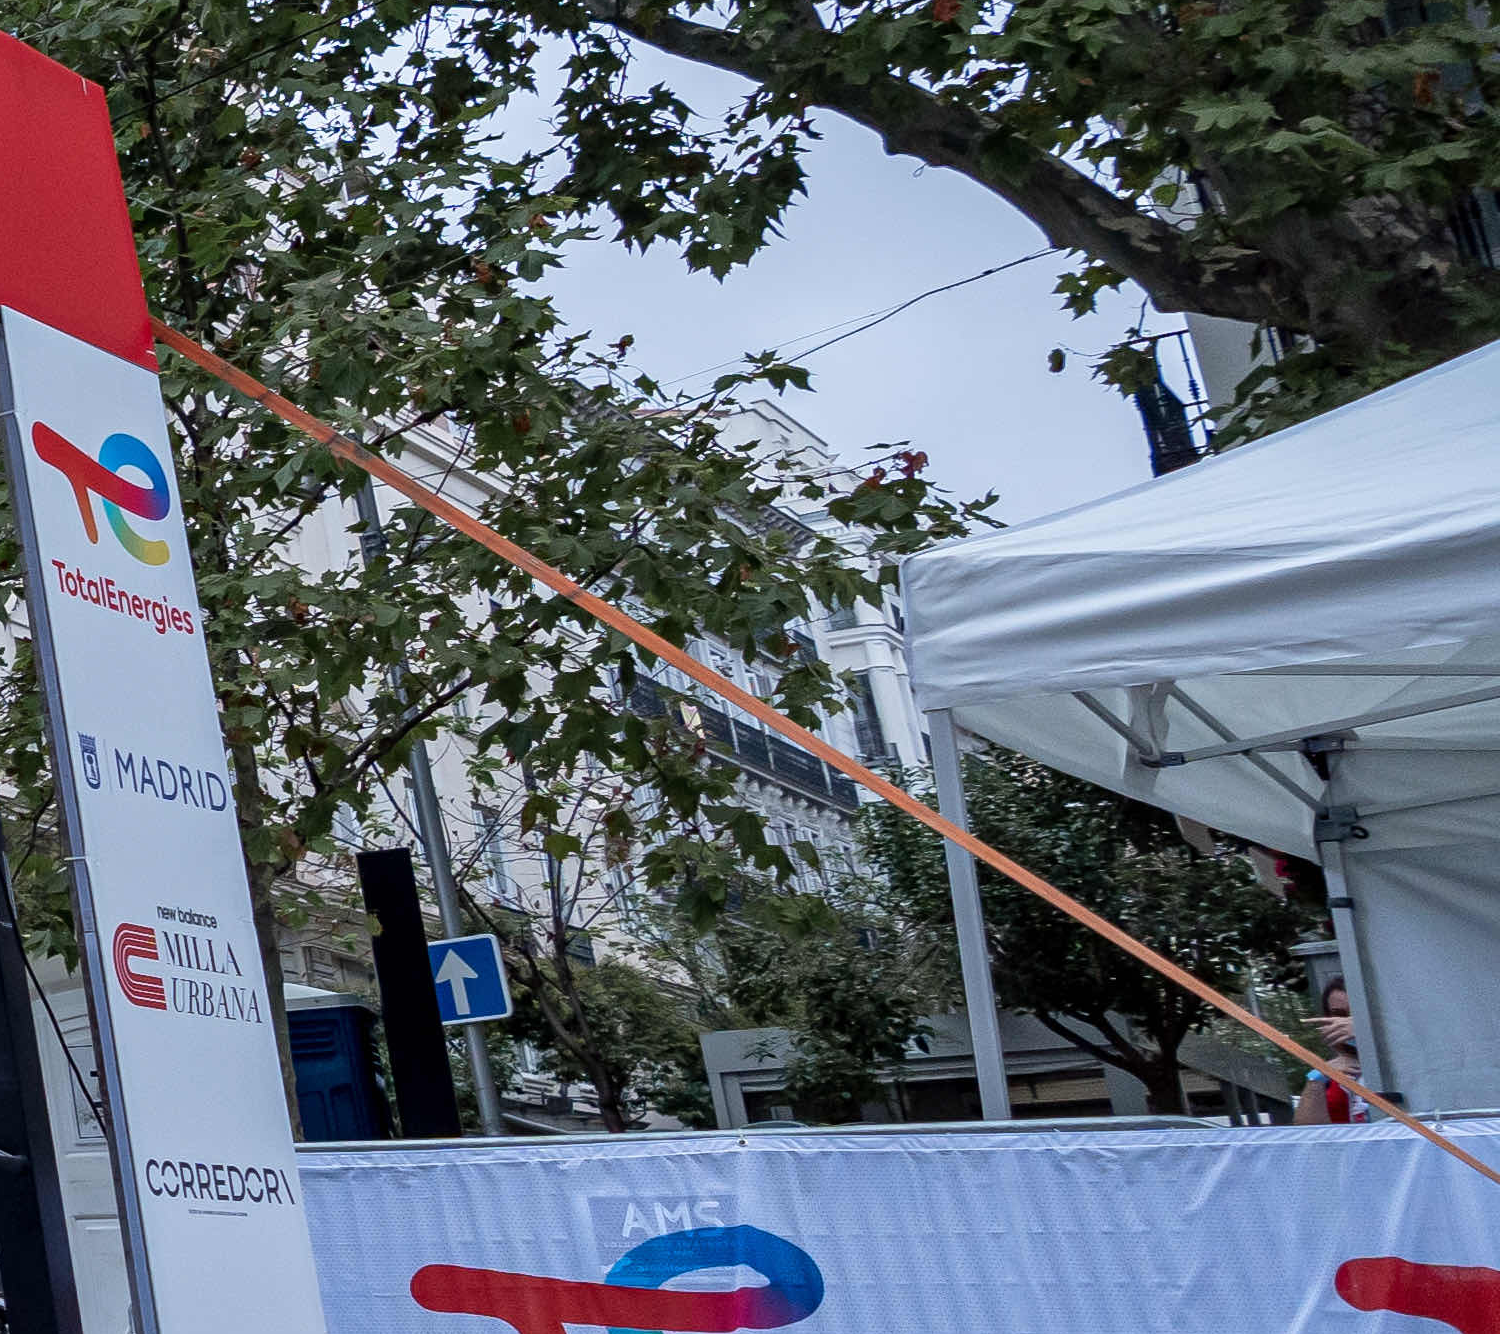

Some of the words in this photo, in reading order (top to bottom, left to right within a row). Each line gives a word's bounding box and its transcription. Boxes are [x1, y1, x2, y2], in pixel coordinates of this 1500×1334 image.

[51, 558, 195, 636] TotalEnergies
[114, 747, 227, 812] MADRID
[156, 905, 176, 921] new
[177, 907, 218, 929] balance
[160, 930, 243, 977] MILLA
[171, 977, 263, 1024] URBANA
[622, 1201, 725, 1238] AMS
